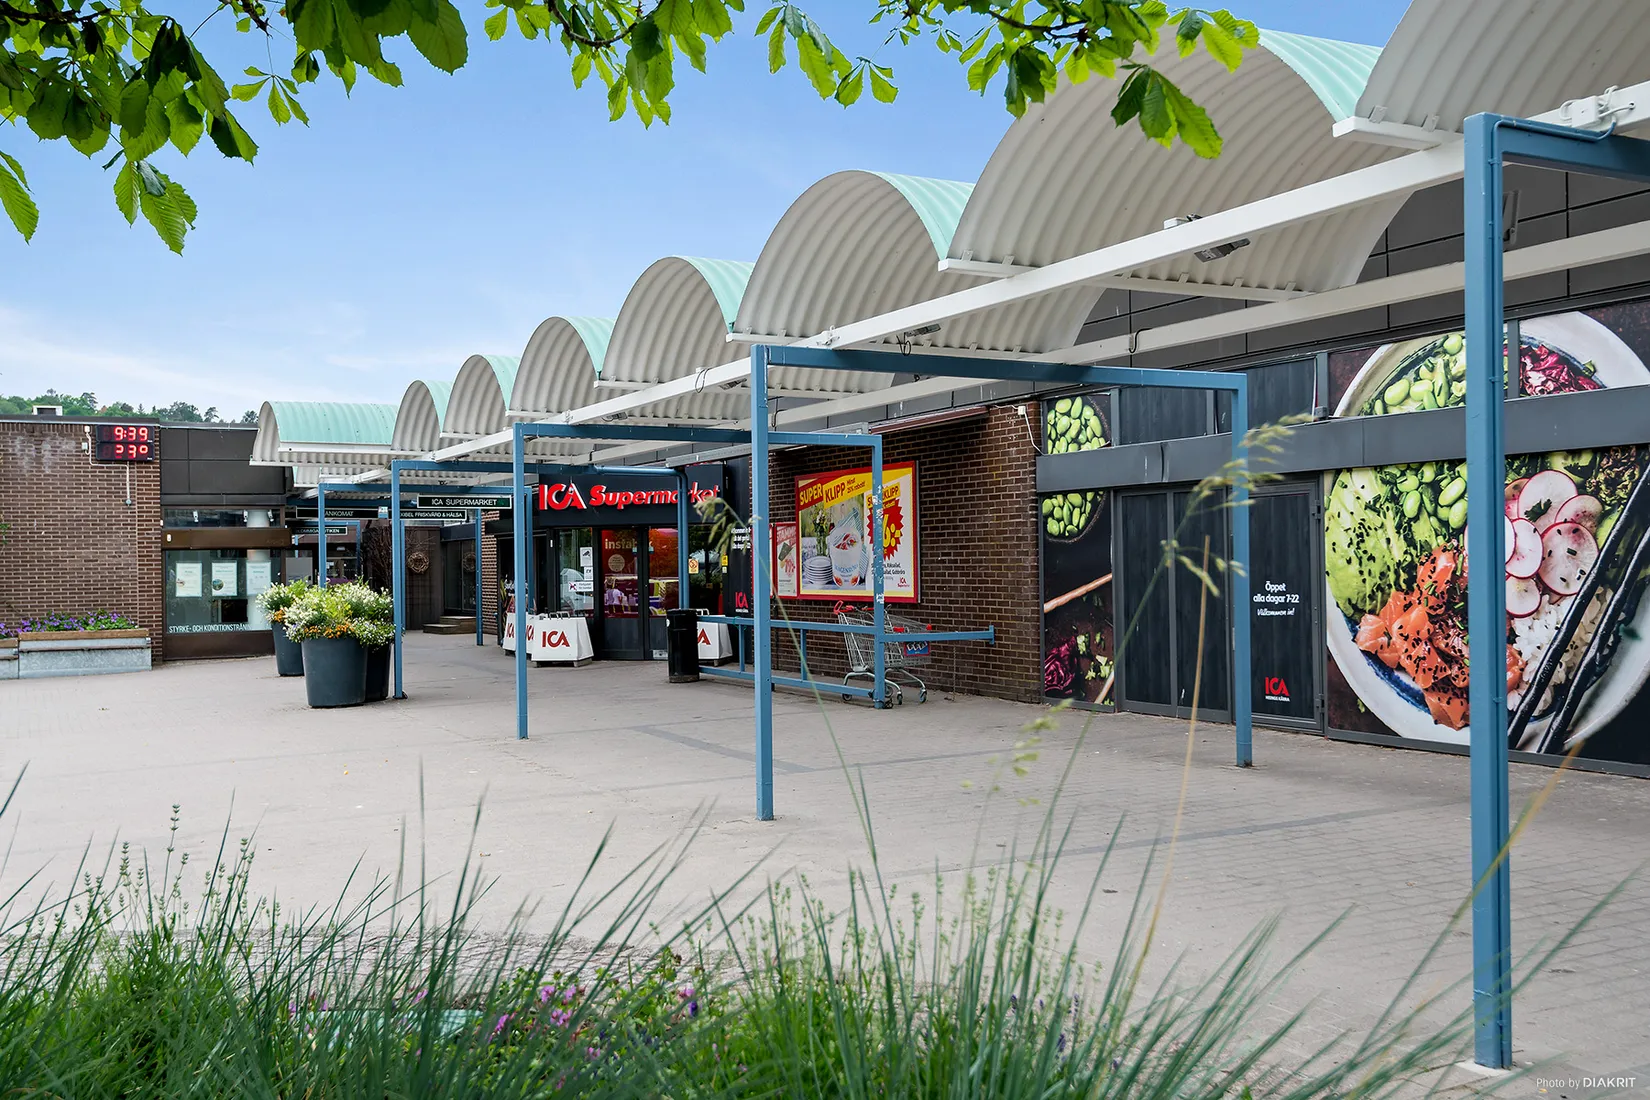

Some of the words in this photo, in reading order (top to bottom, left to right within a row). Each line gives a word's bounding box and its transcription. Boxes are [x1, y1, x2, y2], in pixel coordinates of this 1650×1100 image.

[114, 426, 148, 441] 9:39
[431, 498, 443, 506] ICA
[446, 498, 497, 506] SUPERMARKET
[538, 482, 587, 511] ICA
[589, 481, 720, 510] Supermaket
[799, 483, 823, 506] SUPER
[825, 482, 846, 503] KLIPP
[1265, 580, 1287, 593] Öppet
[735, 591, 749, 608] ICA
[1253, 594, 1265, 603] alla
[1265, 594, 1286, 605] dagar
[1286, 594, 1300, 603] 7-22
[192, 624, 203, 632] OCH
[542, 630, 571, 648] ICA
[1265, 676, 1290, 696] ICA
